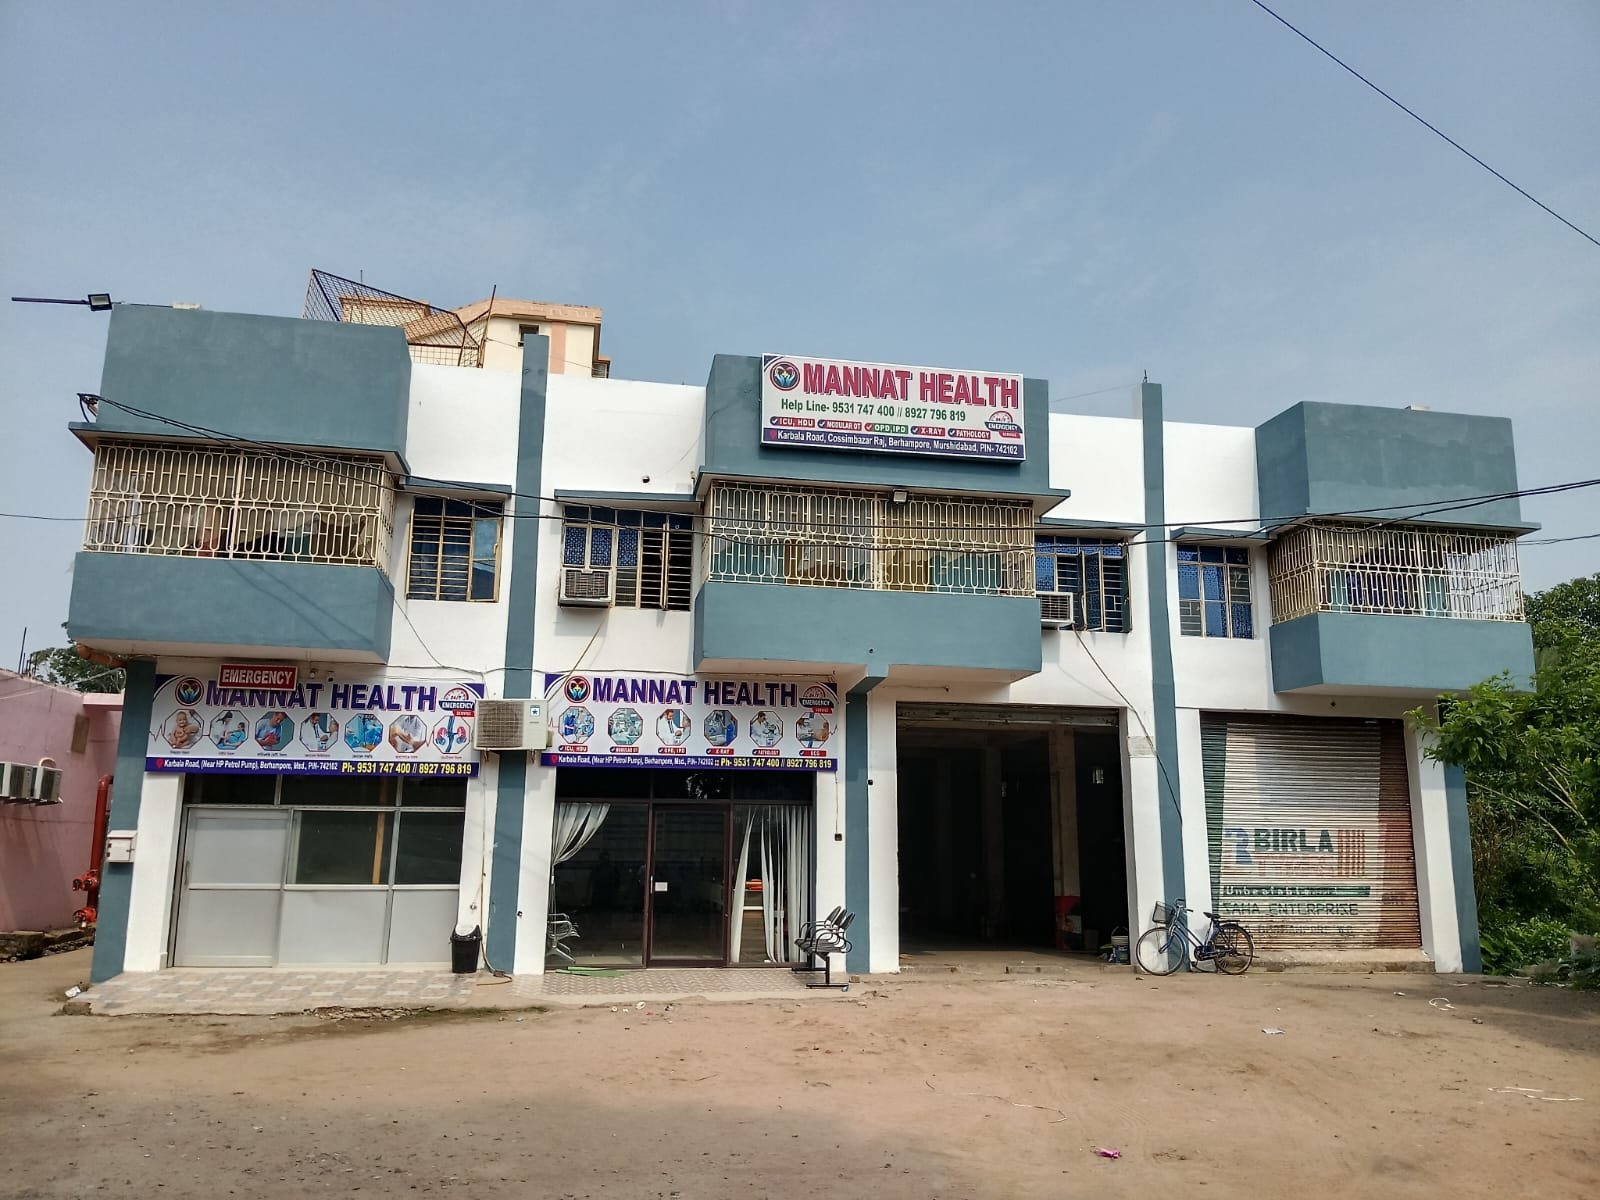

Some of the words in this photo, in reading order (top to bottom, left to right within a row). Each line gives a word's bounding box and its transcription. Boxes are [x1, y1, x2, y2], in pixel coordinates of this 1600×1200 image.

[803, 363, 912, 401] MANNAT
[920, 372, 1018, 409] HEALTH
[781, 398, 803, 413] Help
[806, 400, 830, 412] Line-
[832, 402, 854, 413] 9531
[857, 404, 874, 415] 747
[877, 406, 895, 417] 400
[905, 407, 927, 419] 8927
[930, 409, 947, 420] 796
[950, 411, 966, 422] 819
[797, 419, 813, 427] HDU
[826, 420, 852, 430] MODULAR
[921, 426, 942, 435] X-RAY
[956, 429, 990, 439] PATHOLOGY
[777, 430, 804, 440] Karbala
[806, 432, 826, 442] Road,
[828, 434, 872, 445] Cossimbazar
[874, 436, 887, 447] Raj,
[889, 437, 932, 450] Berhampore,
[933, 440, 978, 453] Murshidabad,
[980, 443, 994, 453] PIN-
[995, 445, 1018, 455] 742102
[222, 669, 293, 684] EMERGENCY
[206, 680, 323, 708] MANNAT
[331, 684, 436, 712] HEALTH
[592, 677, 697, 705] MANNAT
[704, 681, 797, 707] HEALTH
[164, 759, 184, 768] Karbala
[201, 760, 215, 770] (Near
[216, 760, 224, 768] HP
[225, 760, 240, 768] Petrol
[341, 763, 355, 772] Ph-
[357, 763, 376, 773] 9531
[378, 763, 393, 773] 747
[396, 763, 410, 773] 400
[419, 764, 438, 774] 8927
[441, 764, 455, 774] 796
[457, 764, 471, 774] 819
[721, 758, 733, 767] Ph-
[733, 758, 750, 767] 9531
[752, 758, 765, 767] 747
[767, 759, 779, 767] 400
[786, 759, 803, 768] 8927
[804, 759, 818, 768] 796
[819, 760, 832, 768] 819
[1254, 829, 1334, 852] BIRLA
[1222, 903, 1260, 916] SAHA
[1268, 903, 1359, 916] ENTERPRISE
